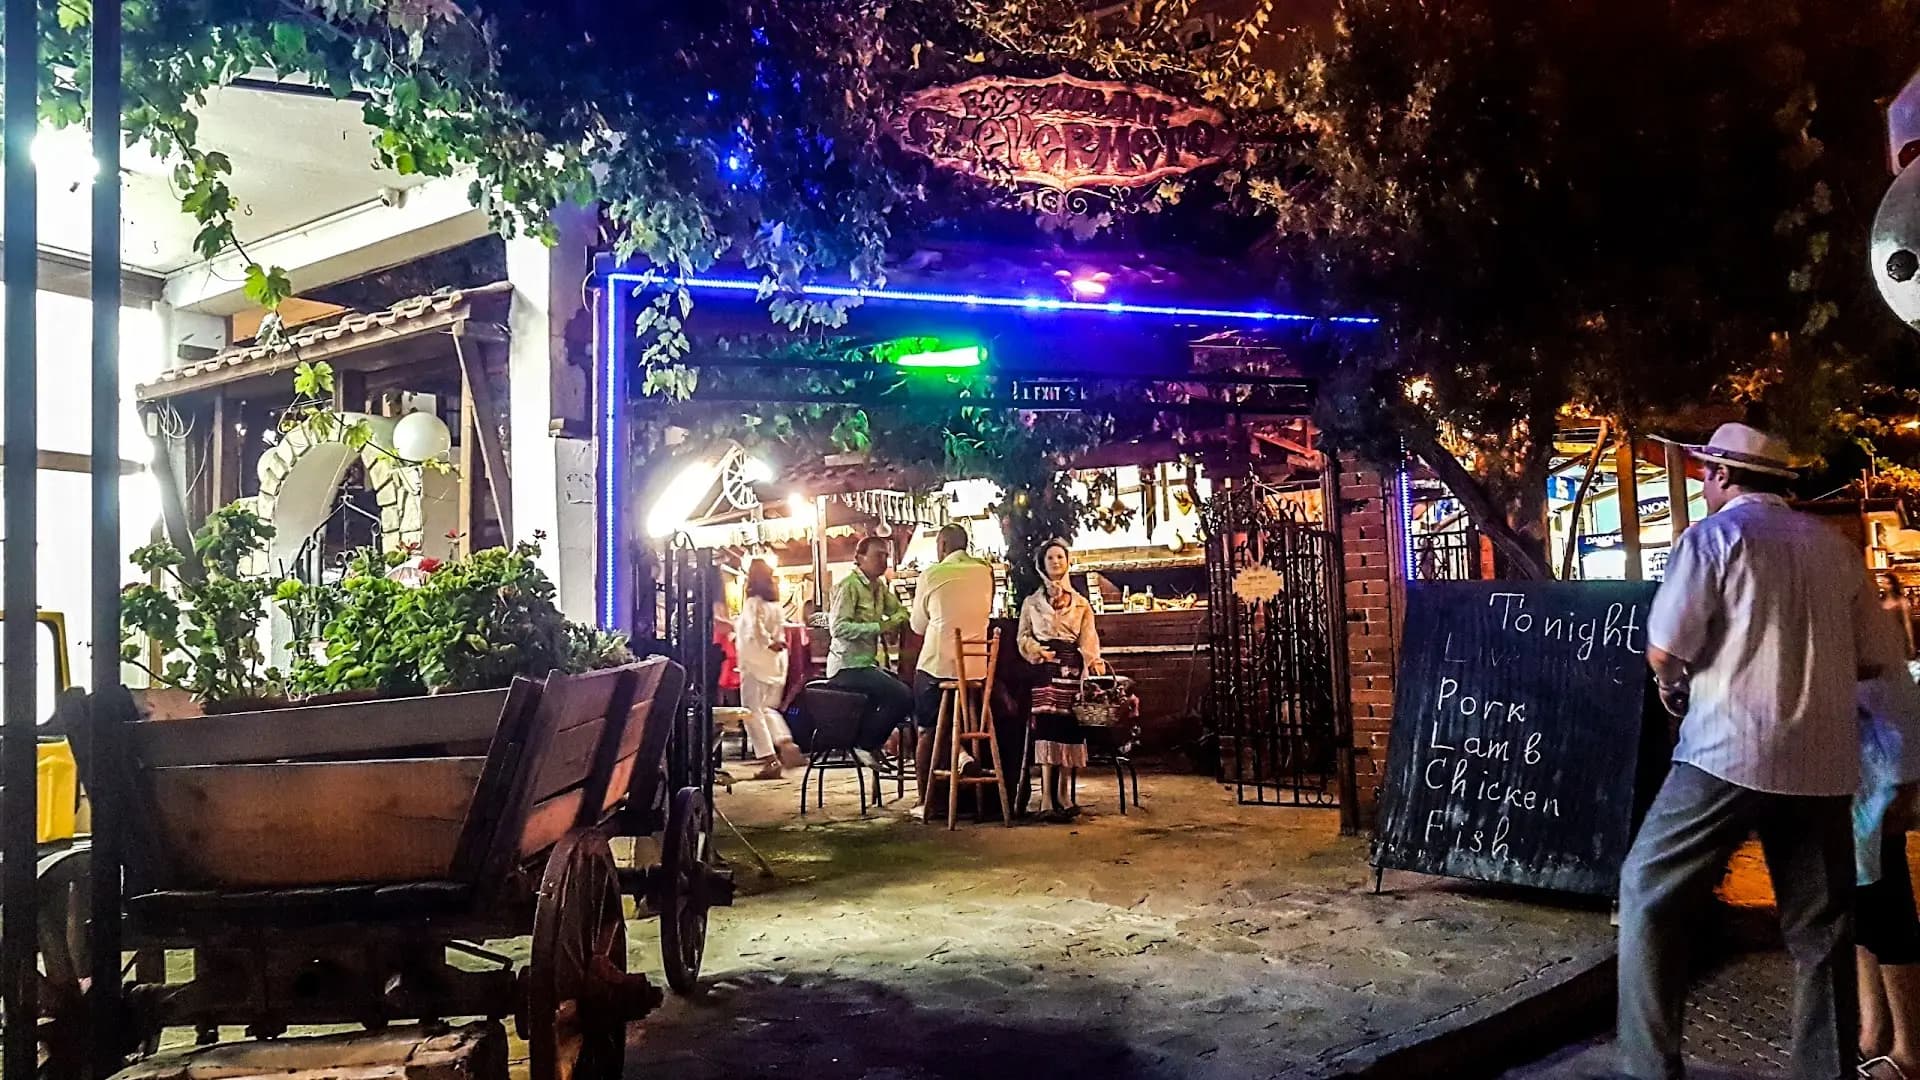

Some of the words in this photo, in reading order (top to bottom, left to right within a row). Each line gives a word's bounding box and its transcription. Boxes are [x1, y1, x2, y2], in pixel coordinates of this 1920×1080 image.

[1489, 592, 1642, 660] Tonight
[1437, 676, 1526, 722] Pork
[1430, 721, 1542, 765] Lamb
[1425, 758, 1560, 817] Chicken
[1424, 809, 1510, 862] Fish
